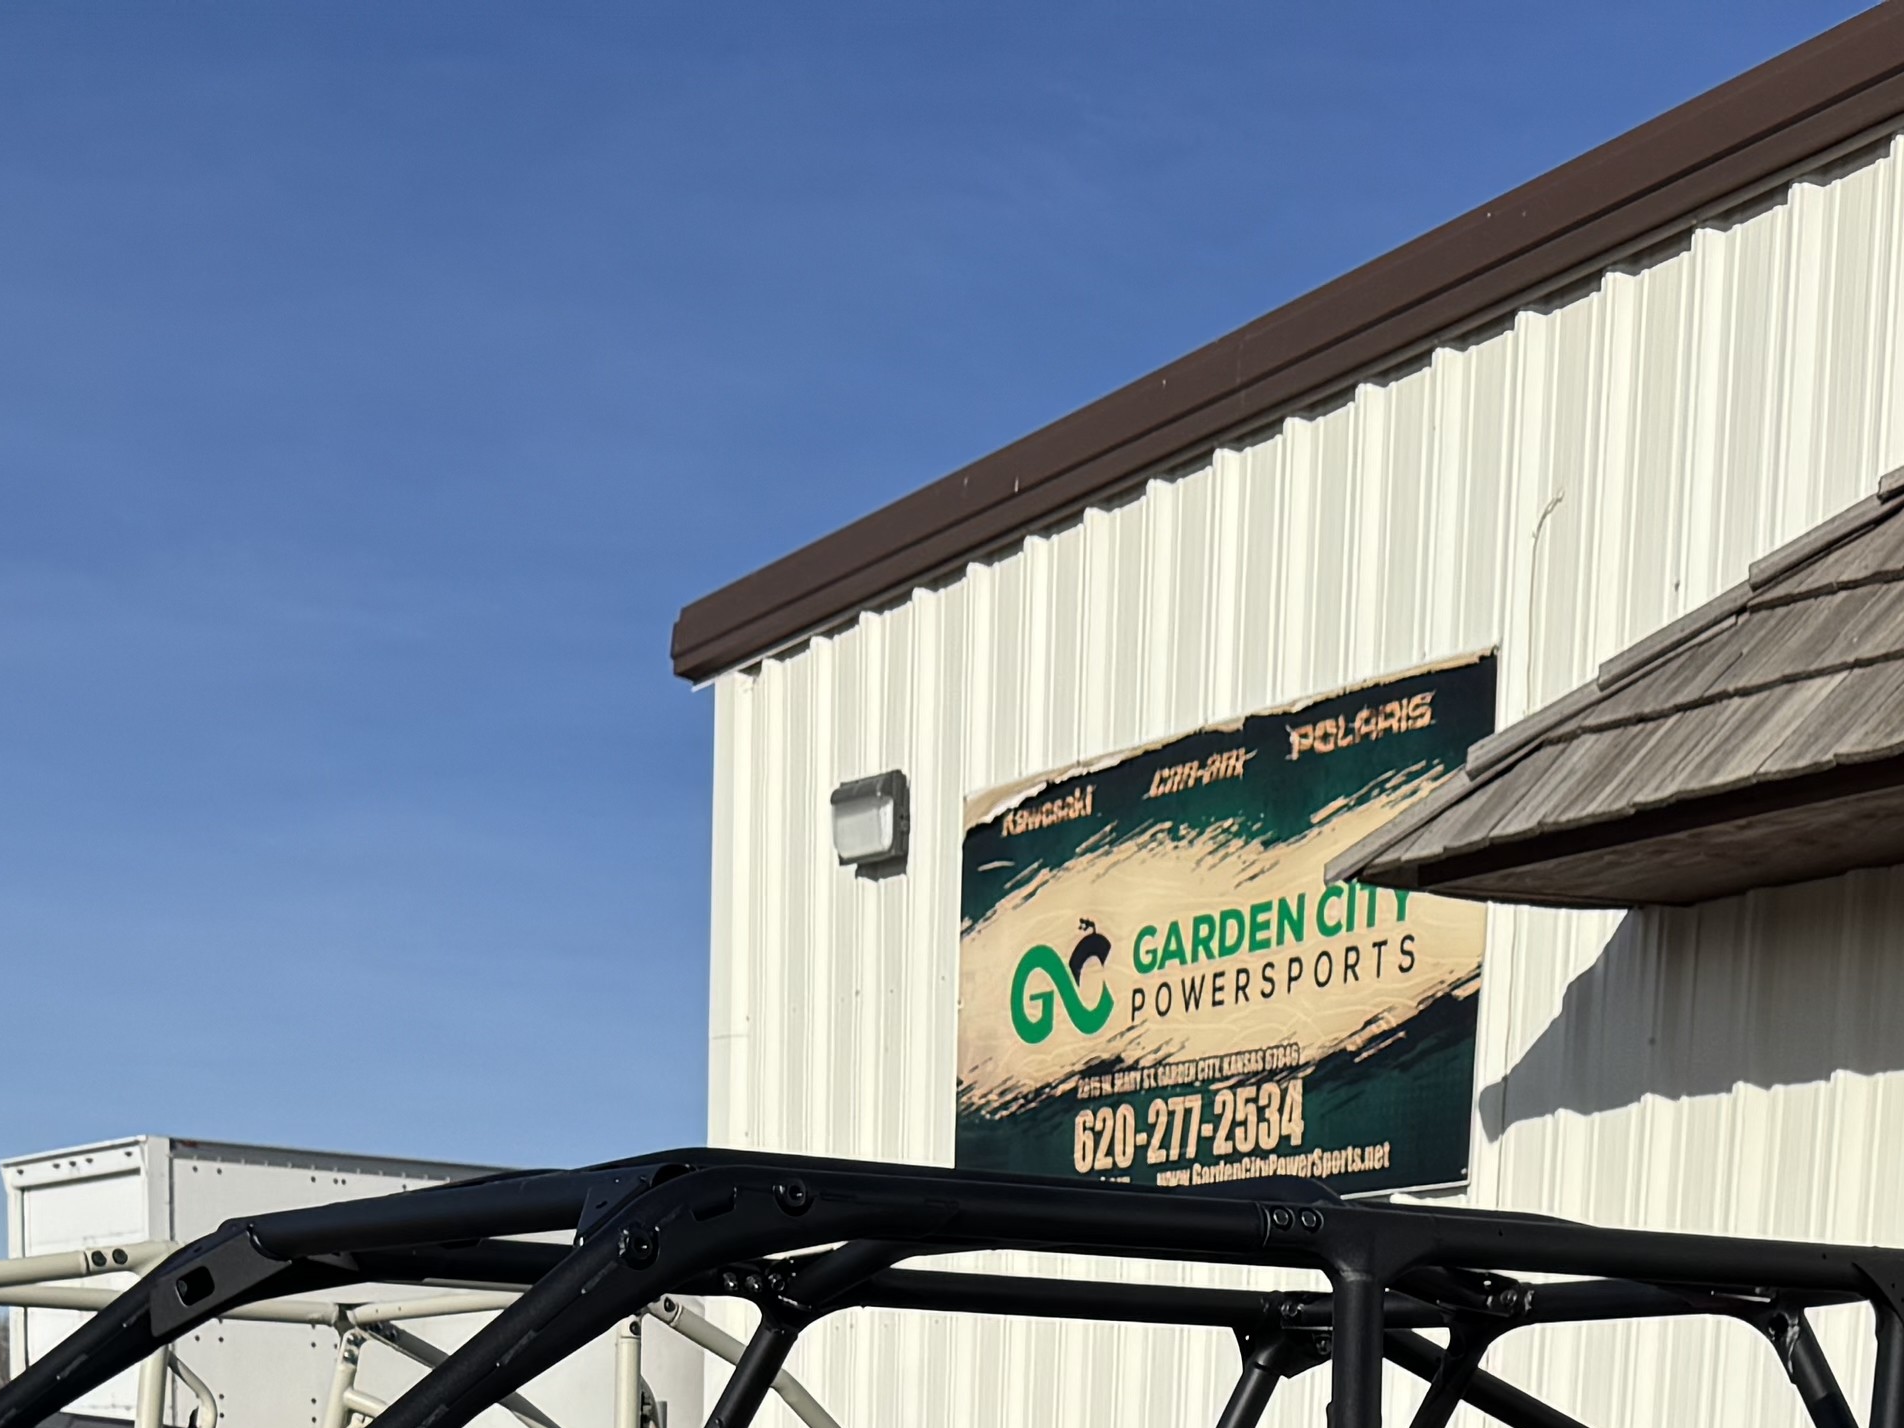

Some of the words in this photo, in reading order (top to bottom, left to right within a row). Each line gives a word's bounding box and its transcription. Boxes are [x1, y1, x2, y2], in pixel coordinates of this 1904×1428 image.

[1286, 689, 1437, 760] POLARIS
[1001, 785, 1093, 837] Kawasaki
[1133, 893, 1306, 974] GARDEN
[1315, 880, 1411, 938] CITY
[1131, 934, 1415, 1022] POWERSPORTS
[1157, 1060, 1196, 1088] GARDEN
[1222, 1049, 1264, 1077] KANSAS
[1073, 1078, 1304, 1174] 620-277-2534
